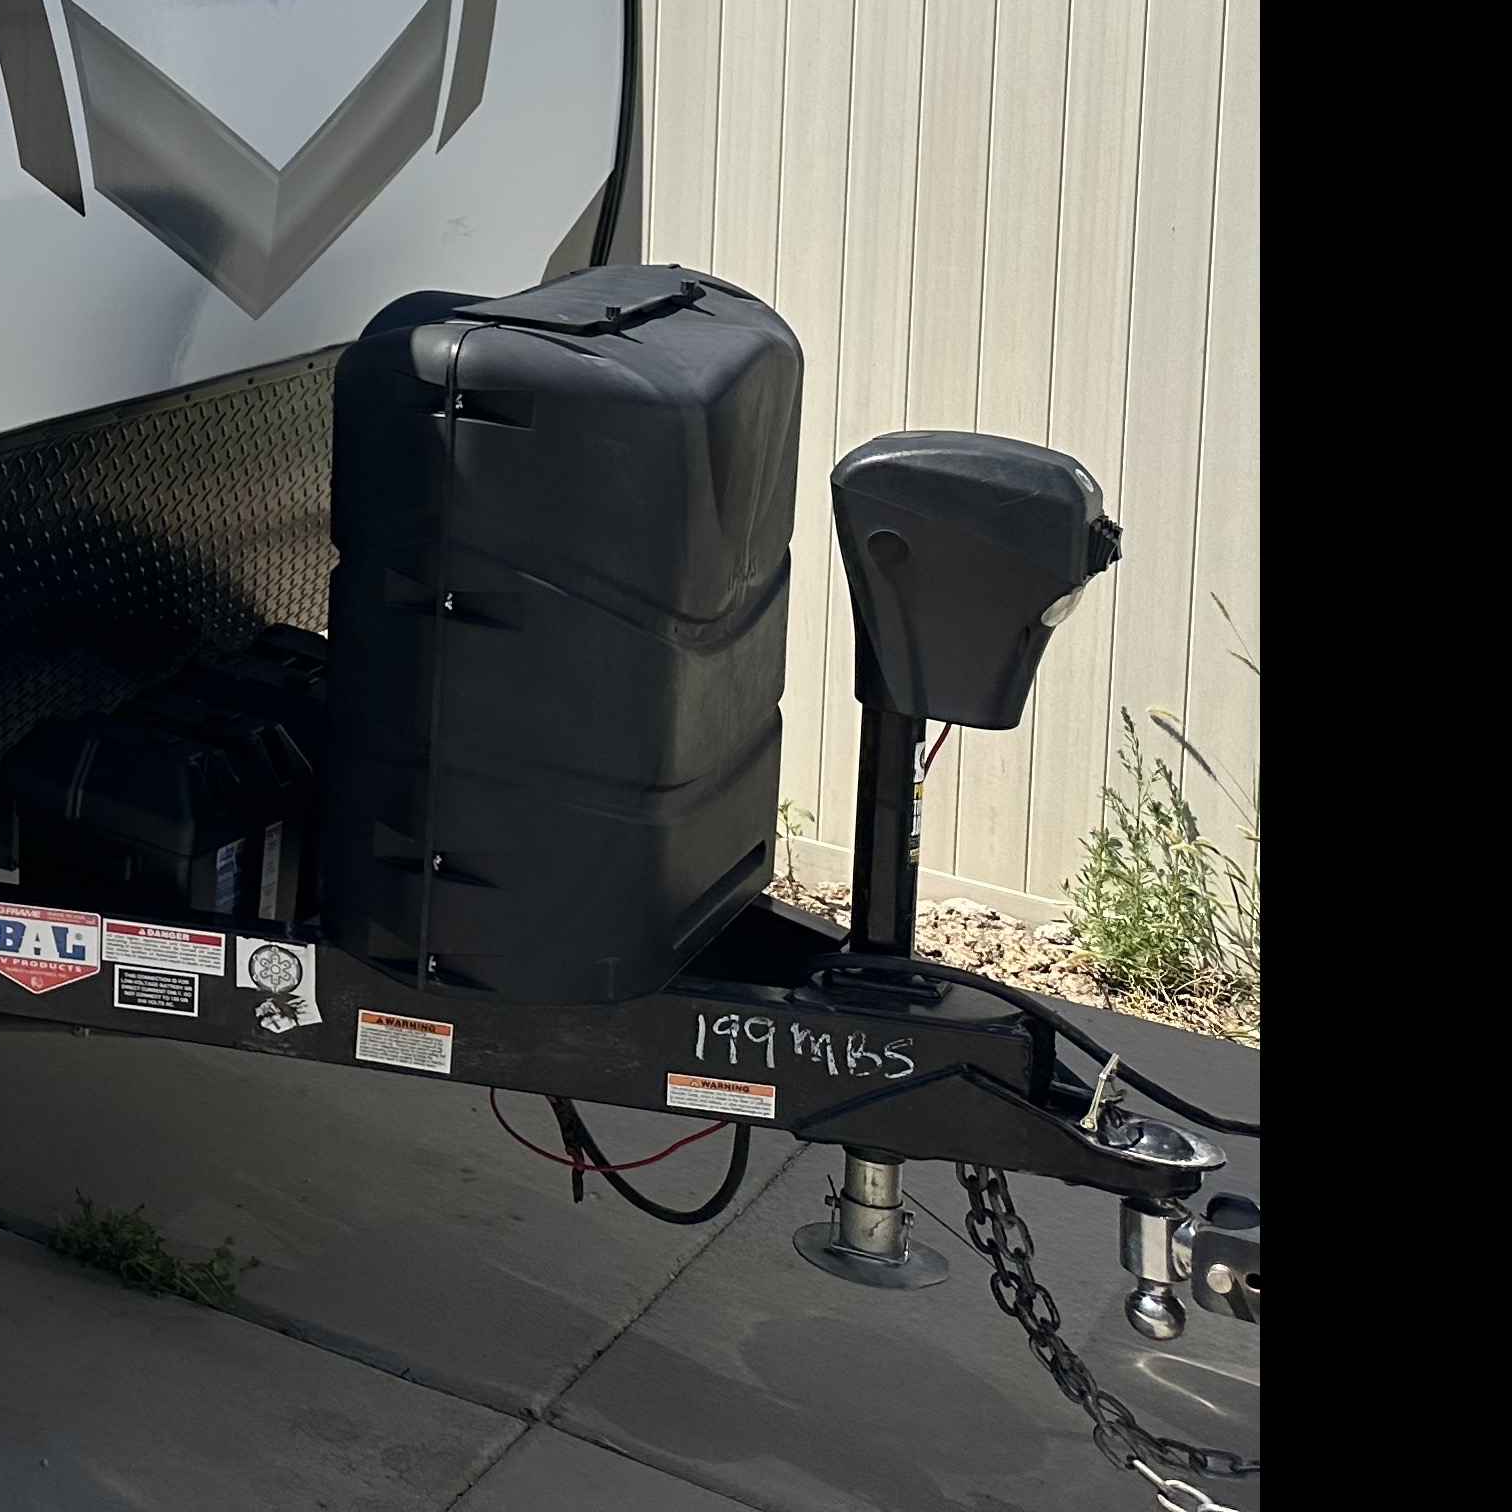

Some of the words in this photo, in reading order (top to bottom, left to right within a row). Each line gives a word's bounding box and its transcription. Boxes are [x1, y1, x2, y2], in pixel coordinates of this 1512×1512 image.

[146, 928, 190, 942] DANGER
[12, 958, 82, 974] PRODUCTS
[385, 1017, 436, 1033] WARNING
[695, 1013, 776, 1069] 199
[701, 1080, 750, 1093] WARNING
